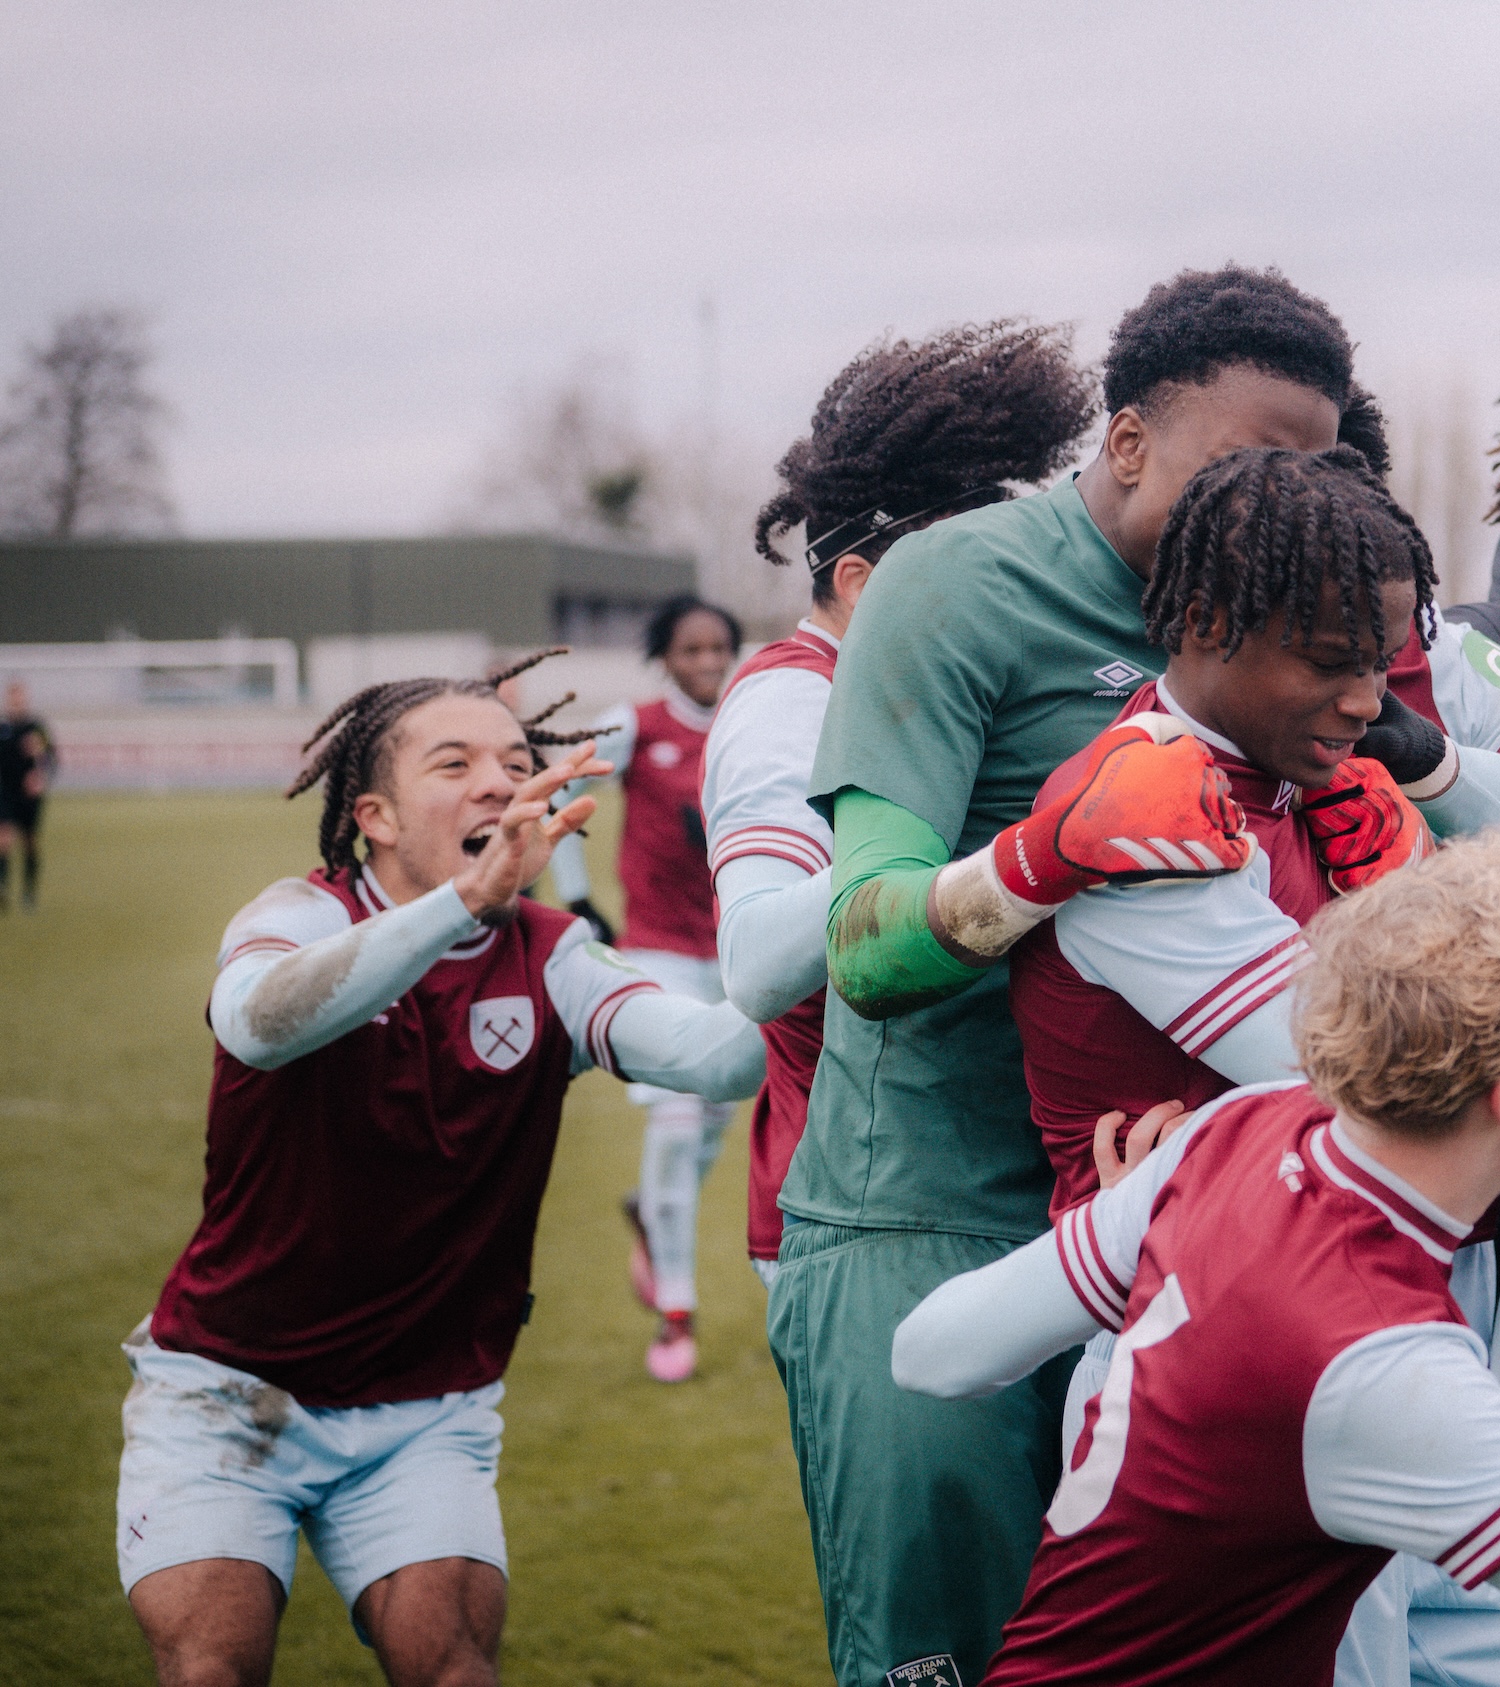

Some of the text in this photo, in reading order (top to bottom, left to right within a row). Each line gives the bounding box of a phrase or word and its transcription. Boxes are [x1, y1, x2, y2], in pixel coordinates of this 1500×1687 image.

[1093, 689, 1129, 697] umbro
[1083, 754, 1128, 820] PREDATOR
[1016, 826, 1038, 886] LAWESU
[895, 1658, 947, 1679] WEST HAM
[907, 1667, 937, 1682] UNITED
